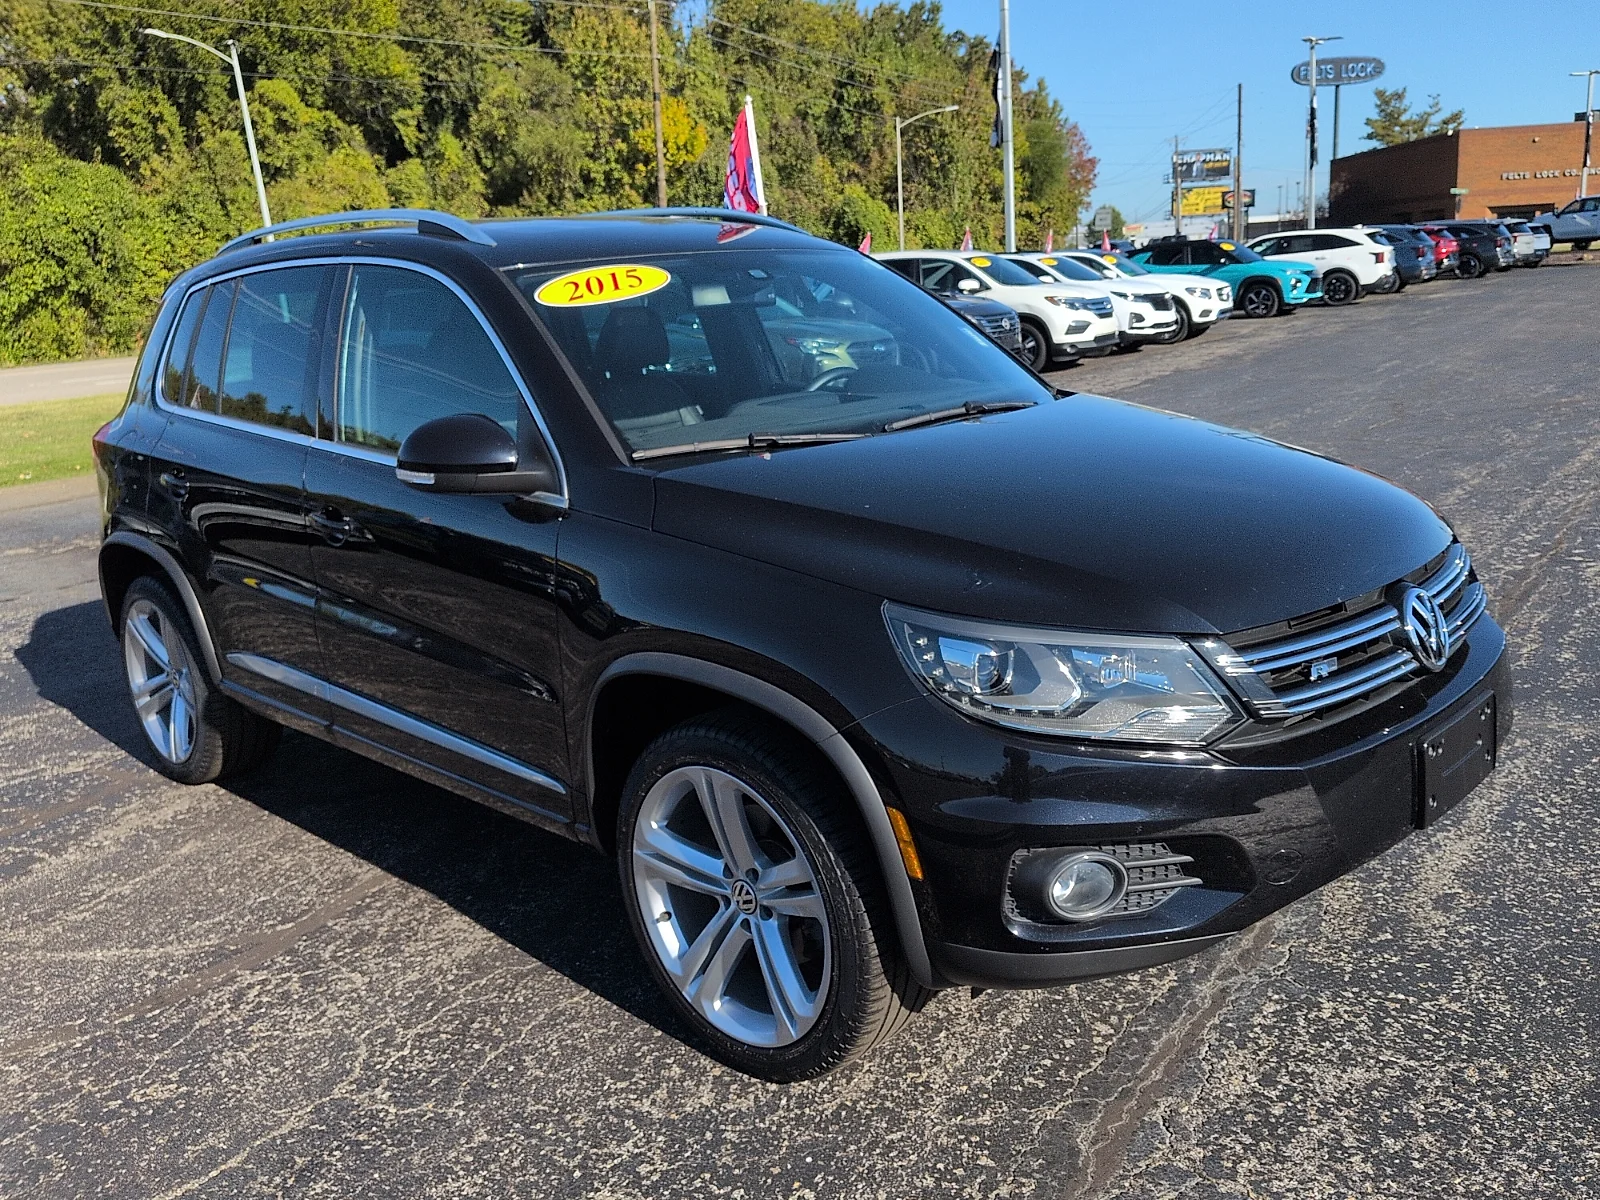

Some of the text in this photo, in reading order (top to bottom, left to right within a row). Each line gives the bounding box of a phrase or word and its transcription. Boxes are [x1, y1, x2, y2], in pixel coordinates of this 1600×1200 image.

[1341, 62, 1375, 78] LOCK
[1502, 171, 1530, 180] FELTS
[1535, 170, 1560, 178] LOCK
[563, 268, 643, 302] 2015
